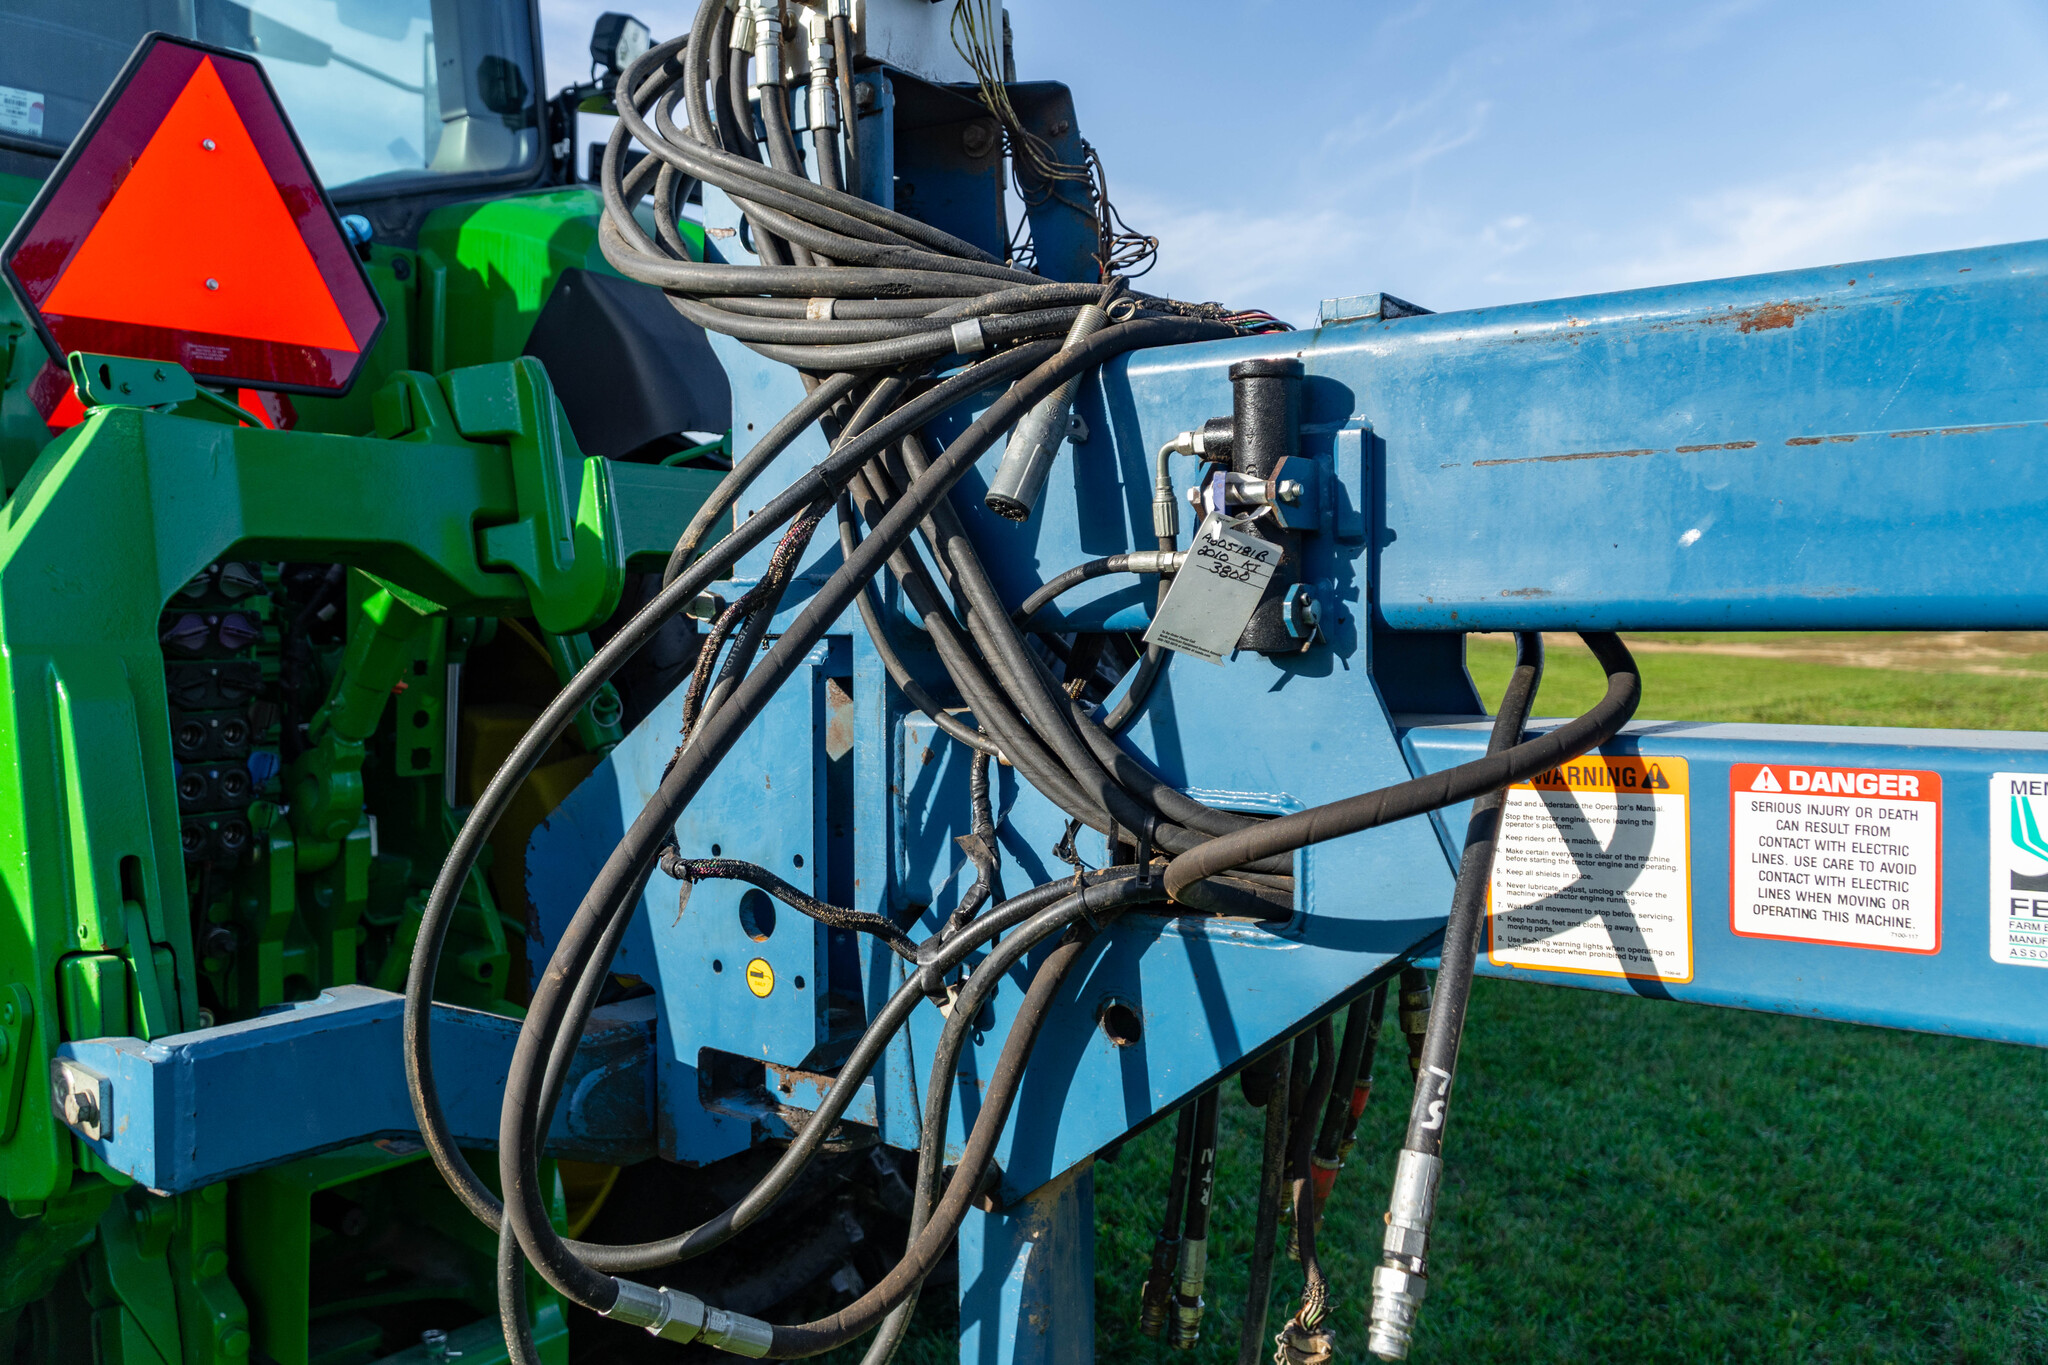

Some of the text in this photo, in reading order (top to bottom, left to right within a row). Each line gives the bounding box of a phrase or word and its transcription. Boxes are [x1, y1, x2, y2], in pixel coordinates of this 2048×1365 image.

[1197, 545, 1229, 562] 2010
[1209, 561, 1250, 581] 3800
[1534, 766, 1636, 788] WARNING
[1789, 770, 1919, 797] DANGER
[2011, 780, 2048, 796] ME
[1595, 803, 1634, 811] Operator's
[1636, 804, 1665, 812] Manual.
[1751, 800, 1918, 821] SERIOUS INJURY OR DEATH
[1542, 822, 1574, 830] platform.
[1561, 816, 1585, 824] engine
[1613, 818, 1640, 826] leaving
[1776, 820, 1891, 837] CAN RESULT FROM
[1758, 836, 1909, 857] CONTACT WITH ELECTRIC
[1530, 857, 1556, 865] starting
[1598, 861, 1622, 869] engine
[1641, 863, 1678, 872] operating.
[1551, 850, 1584, 858] everyone
[1638, 855, 1670, 863] machine
[1752, 852, 1917, 875] LINES. USE CARE TO AVOID
[1758, 870, 1909, 893] CONTACT WITH ELECTRIC
[1528, 883, 1560, 892] lubricate,
[1562, 886, 1587, 894] adjust,
[1589, 888, 1614, 896] unclog
[1626, 890, 1653, 898] service
[1758, 888, 1909, 910] LINES WHEN MOVING OR
[1580, 895, 1604, 903] engine
[1606, 897, 1637, 905] running.
[2011, 898, 2048, 918] FE
[1546, 906, 1583, 914] movement
[1594, 909, 1610, 917] stop
[1613, 910, 1636, 918] before
[1638, 913, 1675, 922] servicing.
[1753, 904, 1916, 929] OPERATING THIS MACHINE.
[1508, 924, 1532, 932] moving
[1526, 917, 1550, 925] hands,
[1583, 922, 1612, 931] clothing
[2009, 921, 2041, 931] FARM
[1508, 944, 1540, 953] highways
[1542, 947, 1565, 955] except
[1589, 950, 1626, 960] prohibited
[1629, 954, 1638, 962] by
[1523, 937, 1550, 946] flashing
[1553, 940, 1580, 949] warning
[1583, 941, 1603, 950] lights
[1628, 946, 1663, 956] operating
[2009, 948, 2048, 959] ASSO
